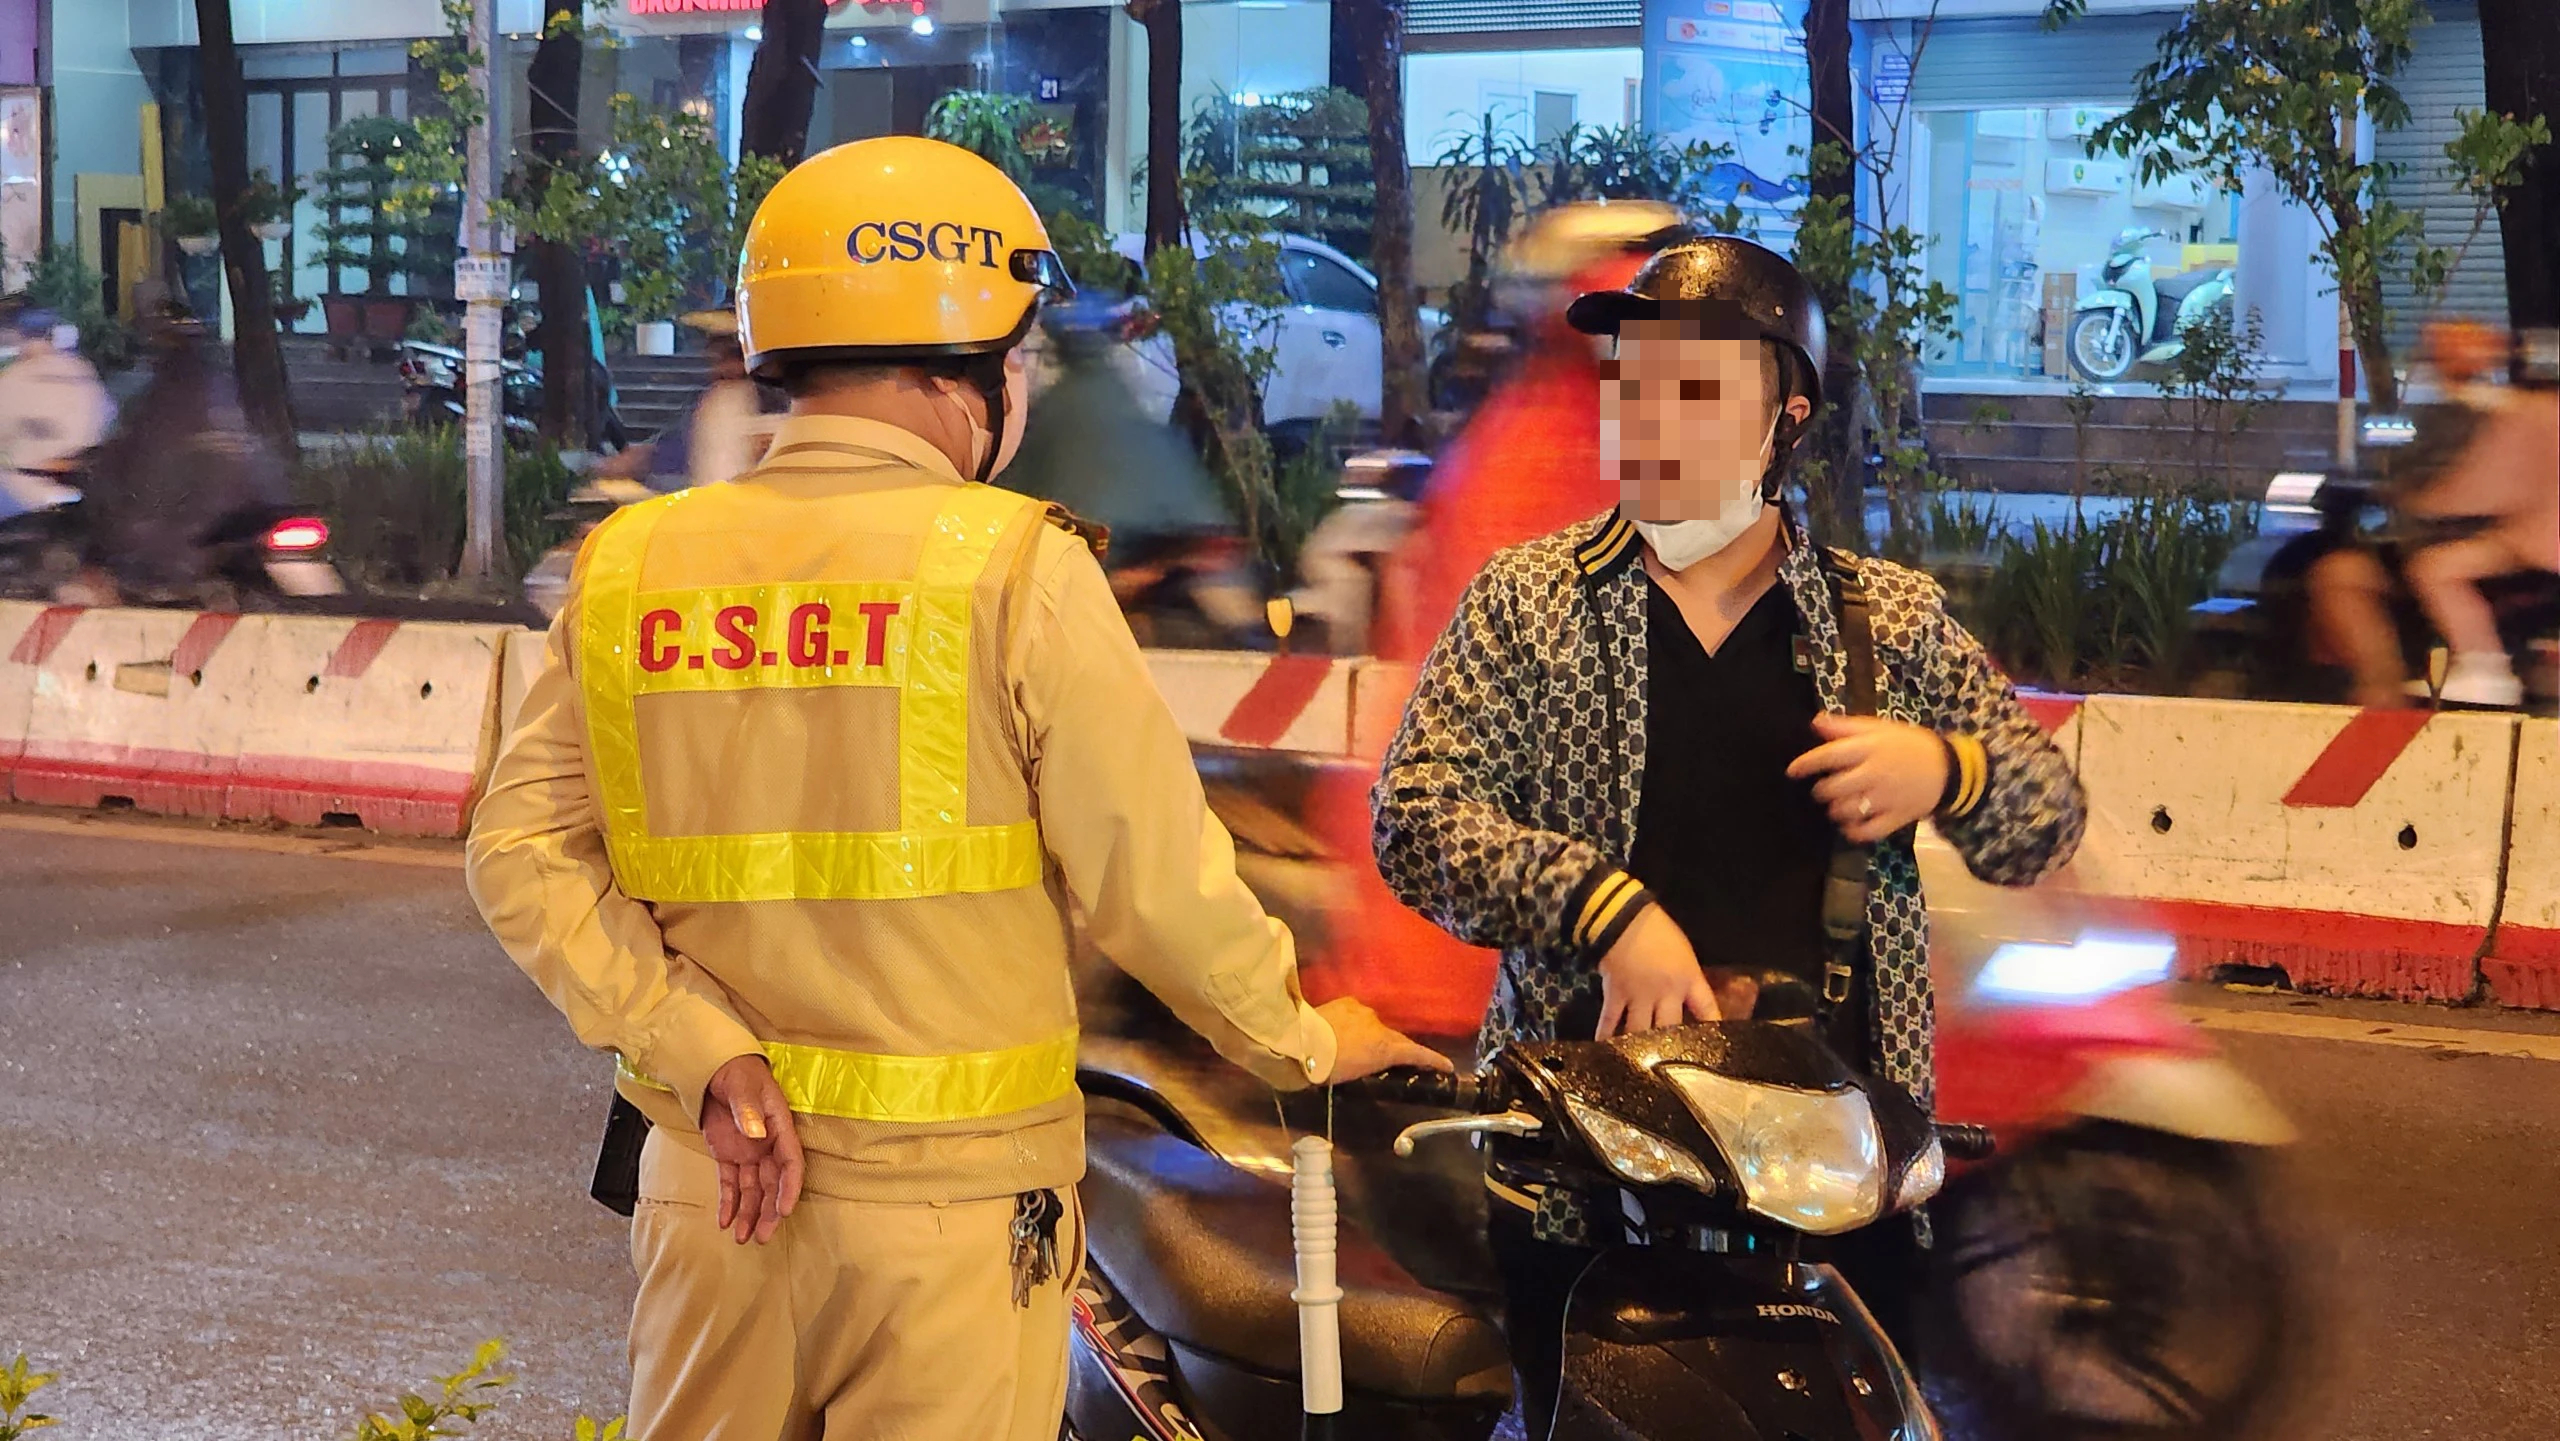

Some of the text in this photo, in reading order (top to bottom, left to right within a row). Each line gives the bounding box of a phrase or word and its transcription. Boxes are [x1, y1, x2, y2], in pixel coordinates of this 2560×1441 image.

[1041, 79, 1058, 99] 21
[846, 220, 1004, 269] CSGT
[638, 602, 901, 673] C.S.G.T
[1755, 1304, 1842, 1325] HONDA
